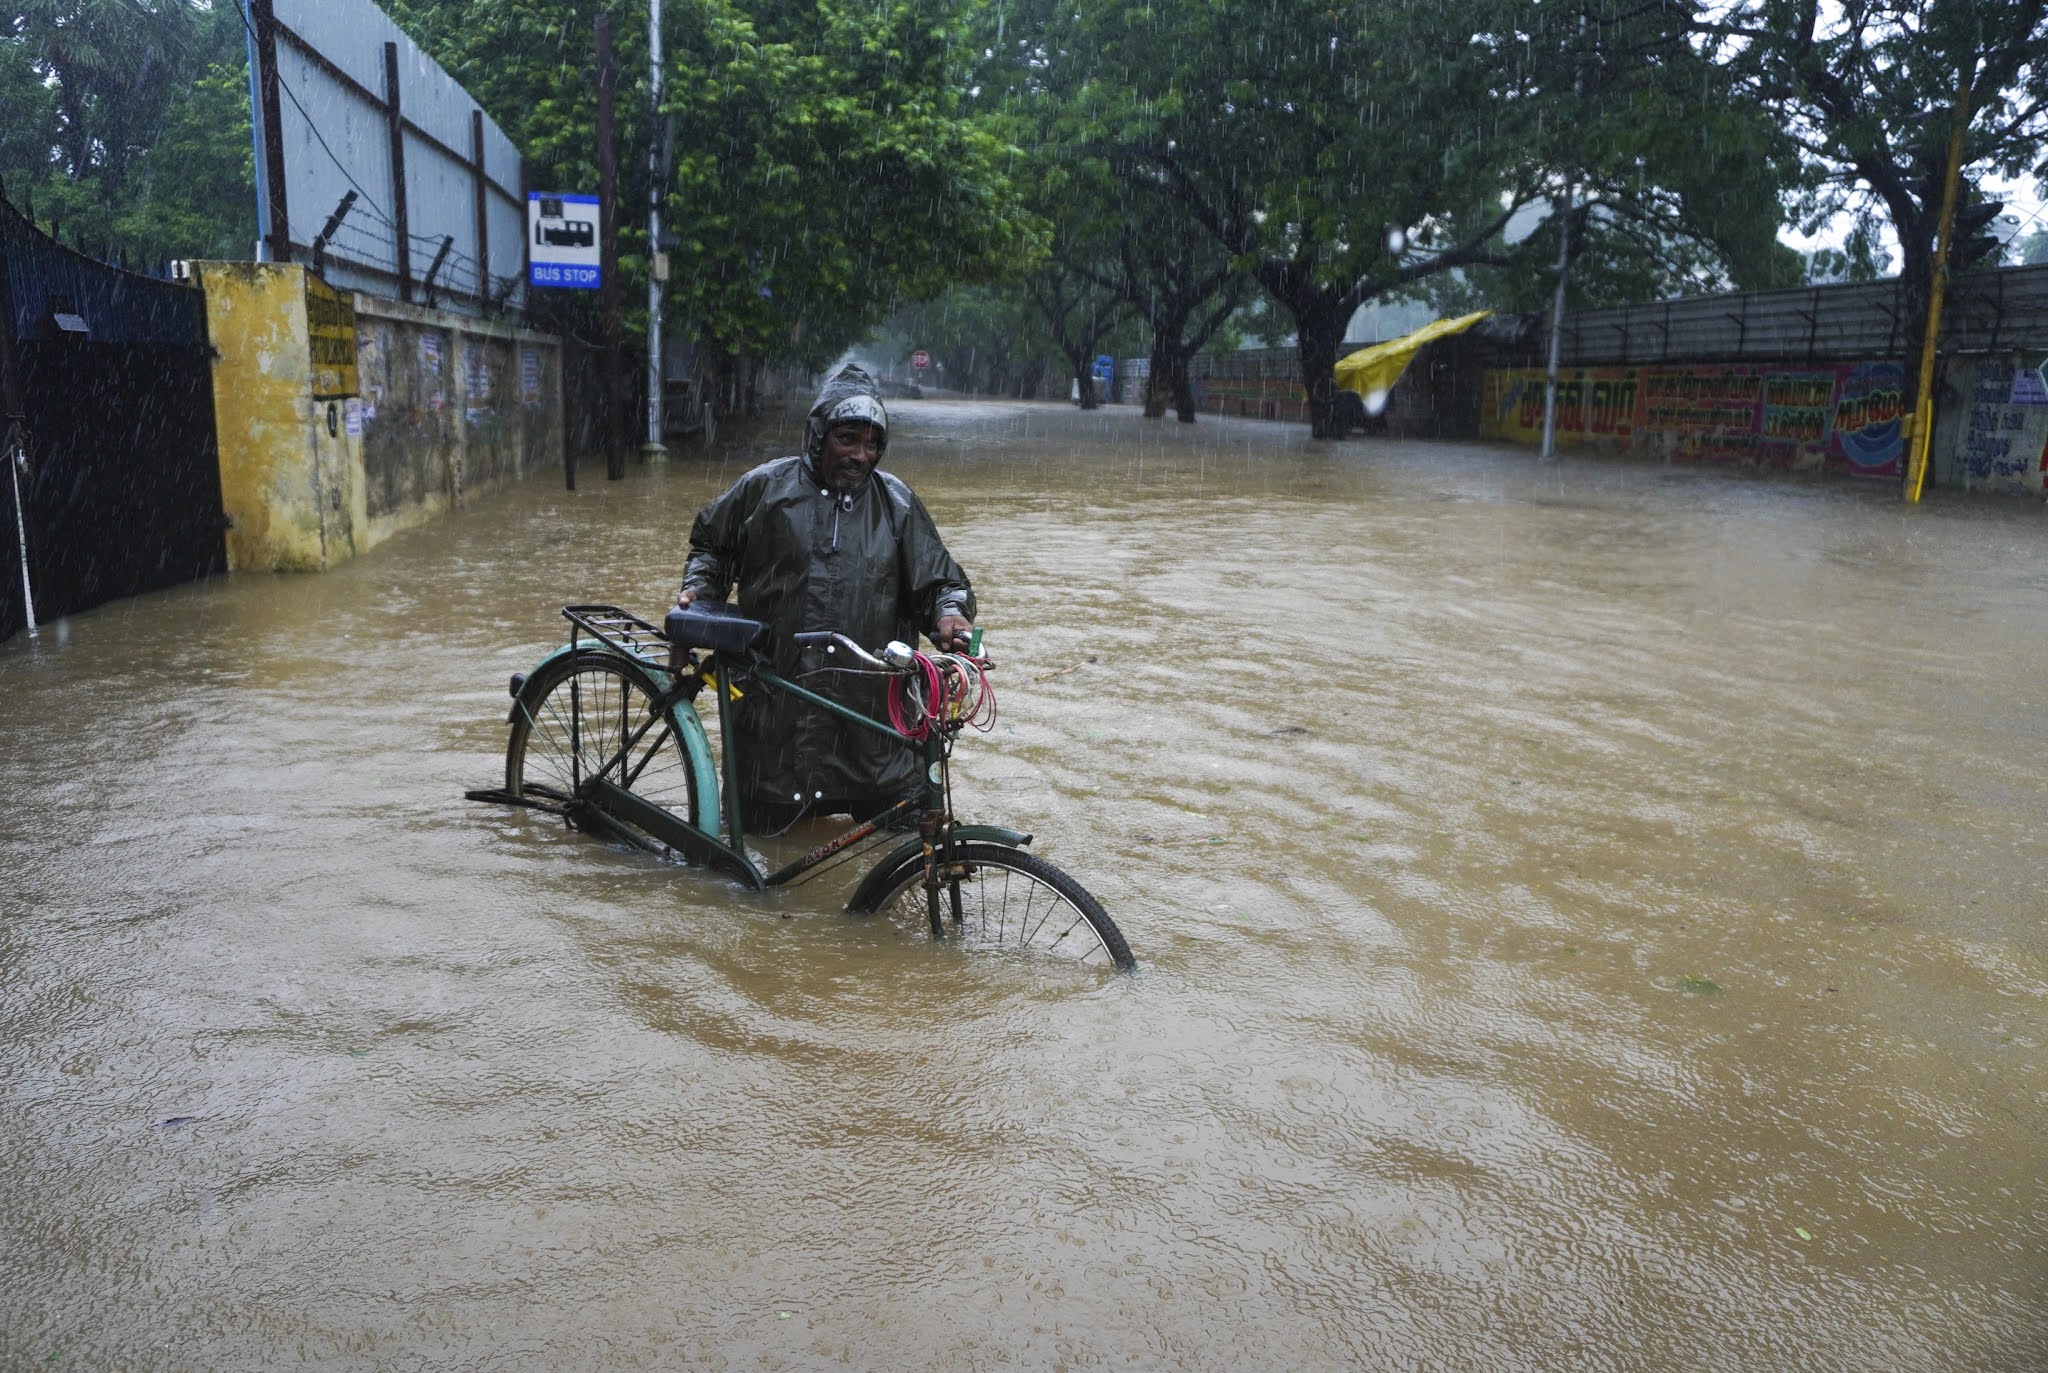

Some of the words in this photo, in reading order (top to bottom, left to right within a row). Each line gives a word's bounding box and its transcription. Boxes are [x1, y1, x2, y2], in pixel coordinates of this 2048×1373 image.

[534, 267, 560, 281] BUS
[563, 268, 597, 282] STOP
[913, 355, 928, 364] STOP
